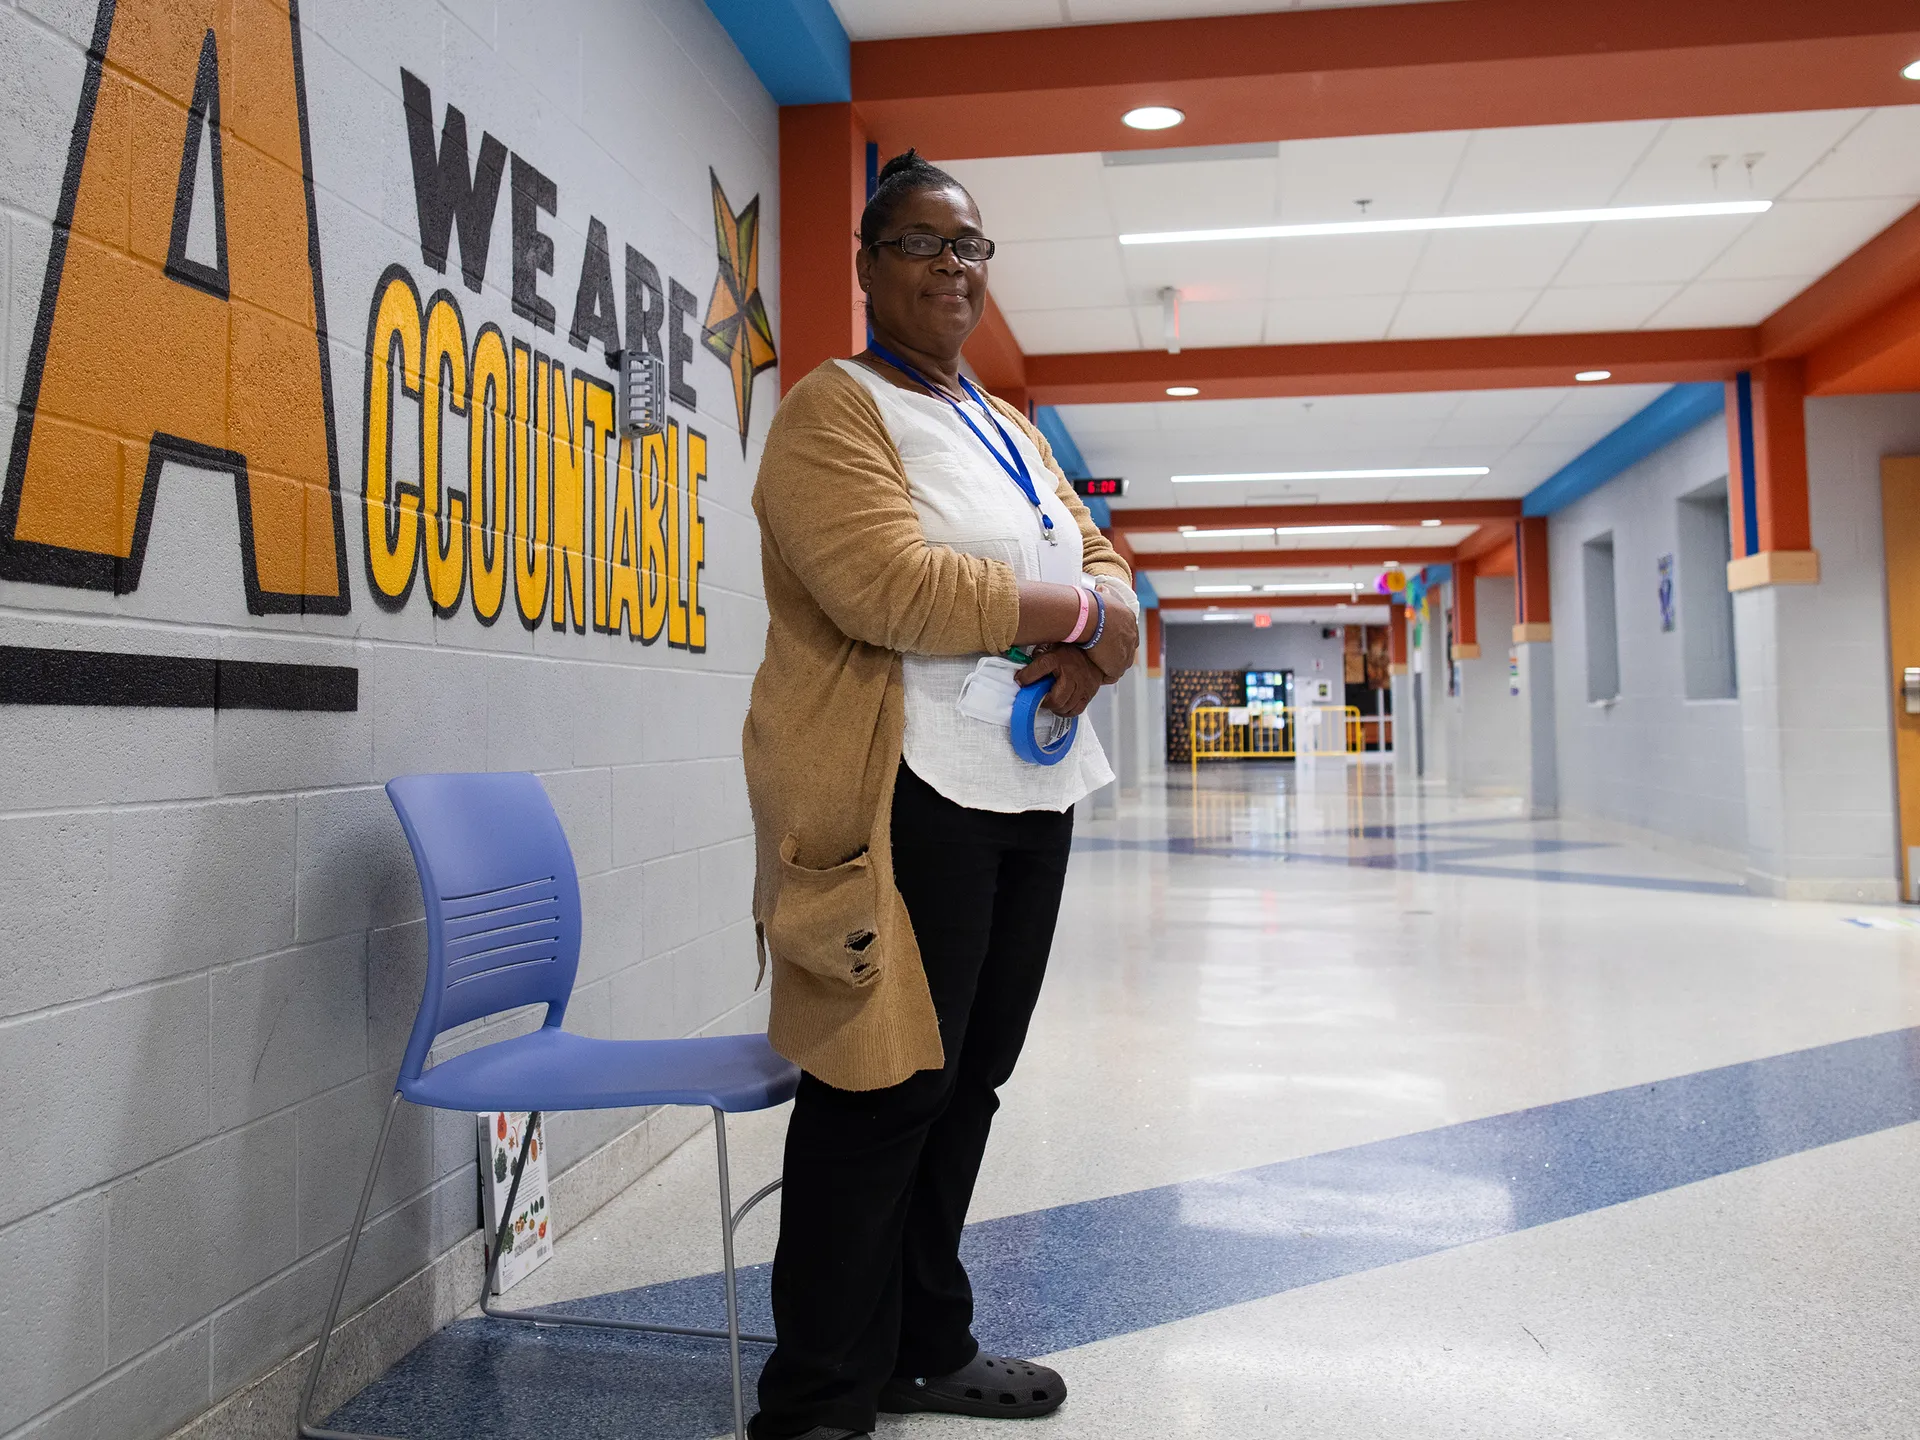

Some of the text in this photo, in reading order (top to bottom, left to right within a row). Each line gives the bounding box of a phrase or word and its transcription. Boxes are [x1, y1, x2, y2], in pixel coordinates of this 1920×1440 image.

[400, 67, 698, 413] WE ARE
[1093, 632, 1102, 644] Teal
